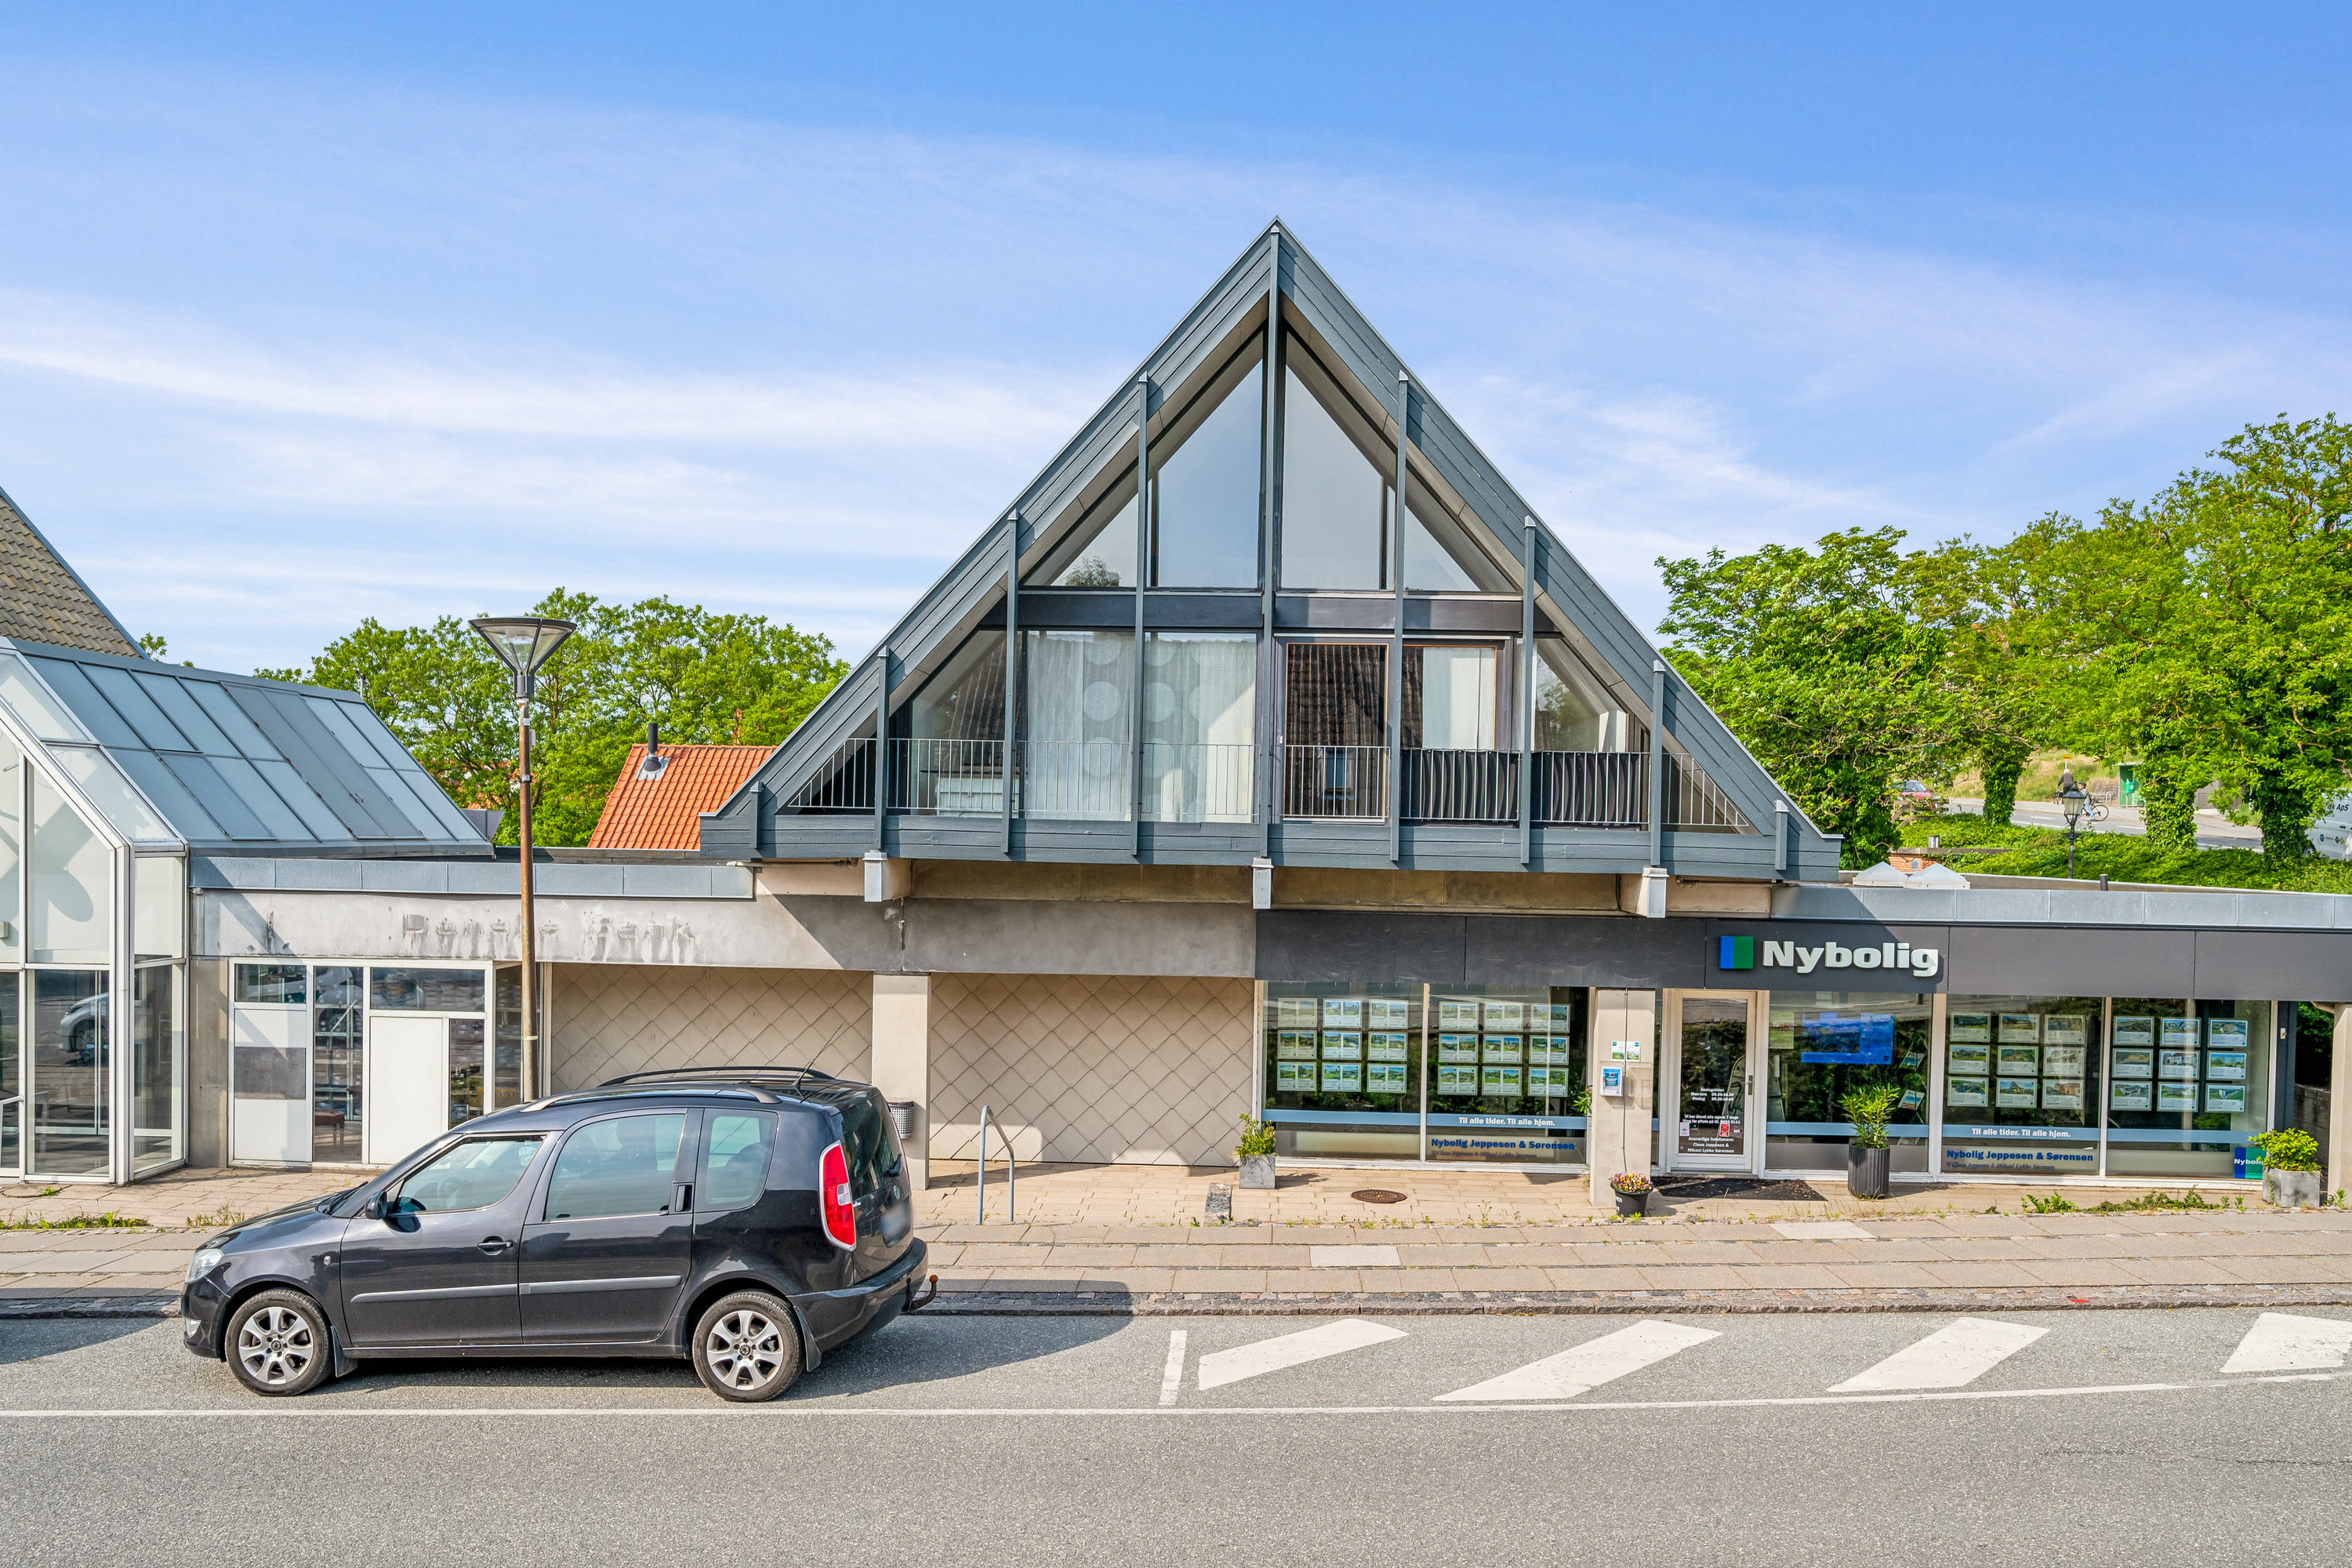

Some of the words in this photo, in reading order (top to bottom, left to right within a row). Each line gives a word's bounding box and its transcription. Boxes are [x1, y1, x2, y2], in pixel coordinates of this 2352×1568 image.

[2336, 803, 2350, 812] ApS
[1762, 941, 1939, 978] Nybolig
[1534, 1118, 1555, 1127] hjem.
[2049, 1130, 2071, 1138] hjem.
[1431, 1138, 1468, 1149] Nybolig
[1469, 1139, 1516, 1149] Jeppesen
[1529, 1141, 1576, 1149] Sørensen
[1946, 1150, 1984, 1160] Nybolig
[1986, 1151, 2034, 1160] Jeppesen
[2036, 1152, 2044, 1160] &
[2046, 1152, 2094, 1161] Sørensen
